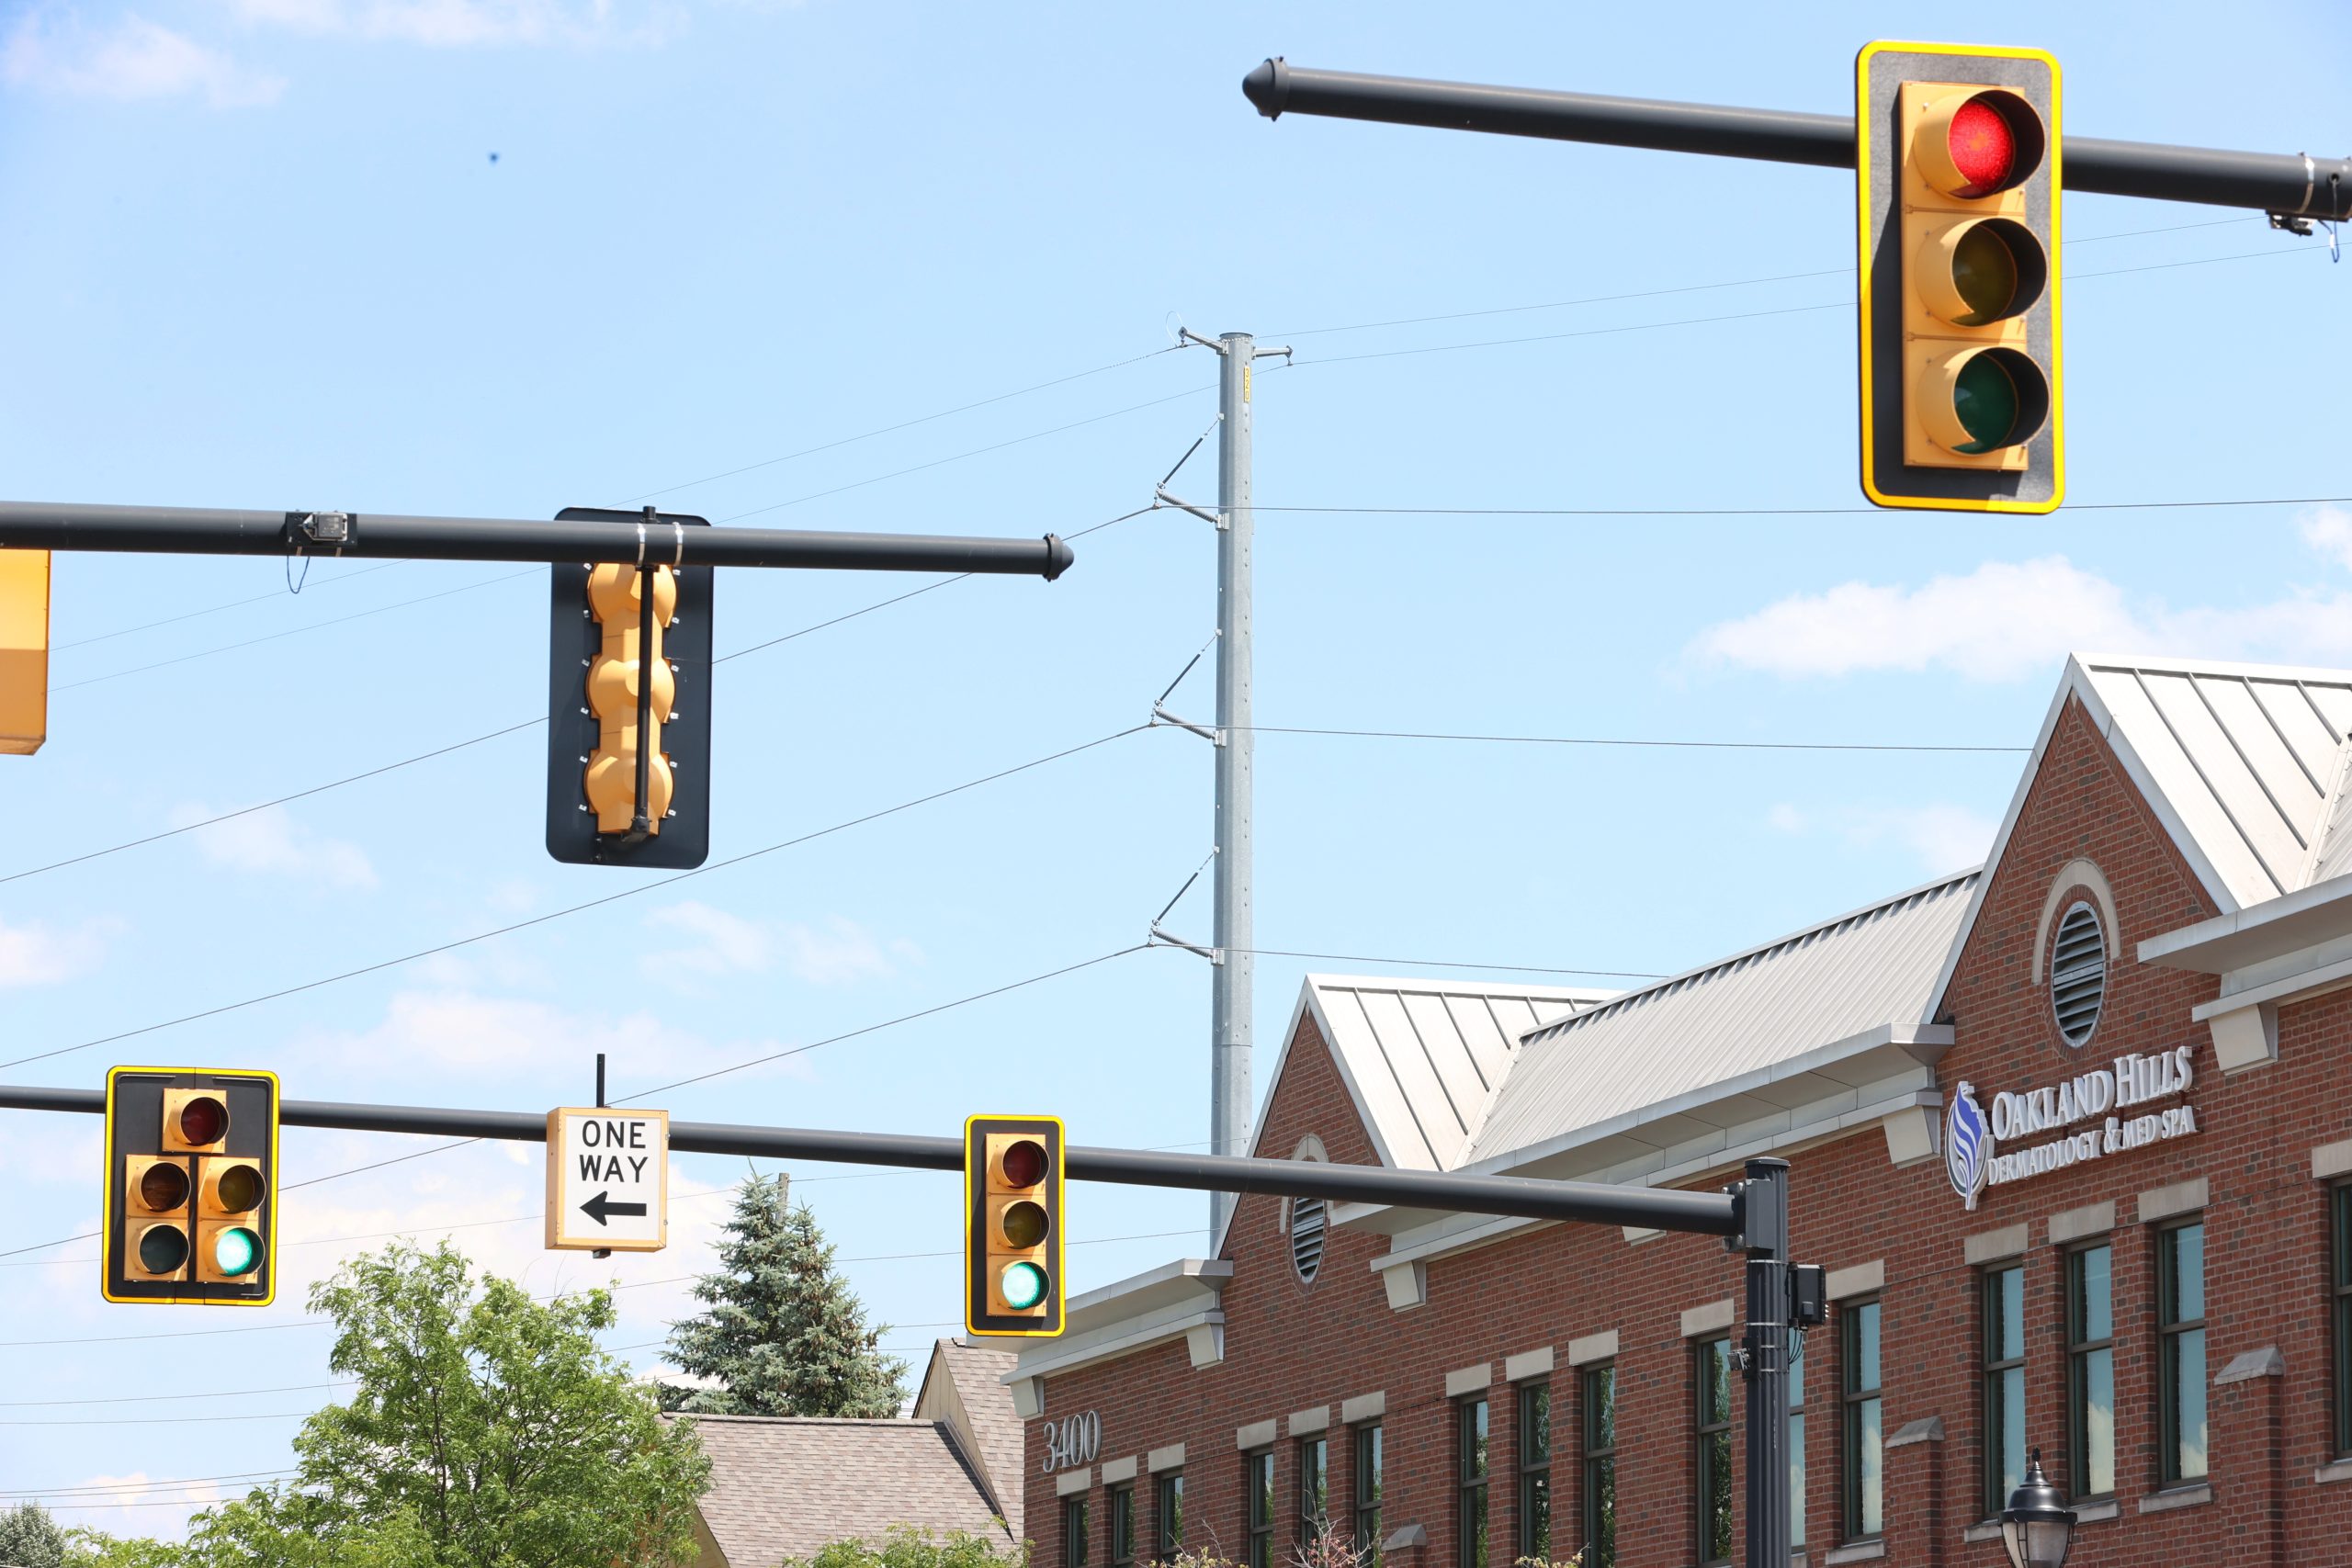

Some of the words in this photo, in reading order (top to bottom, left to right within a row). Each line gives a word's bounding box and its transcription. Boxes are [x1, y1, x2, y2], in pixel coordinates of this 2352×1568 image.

[1992, 1070, 2114, 1141] OAKLAND
[2115, 1045, 2193, 1108] HILLS
[582, 1120, 646, 1148] ONE
[1987, 1130, 2104, 1185] DERMATOLOGY
[2104, 1116, 2122, 1154] &
[2122, 1115, 2161, 1149] MED
[2162, 1105, 2198, 1139] SPA
[579, 1154, 649, 1183] WAY
[1043, 1410, 1101, 1473] 3400
